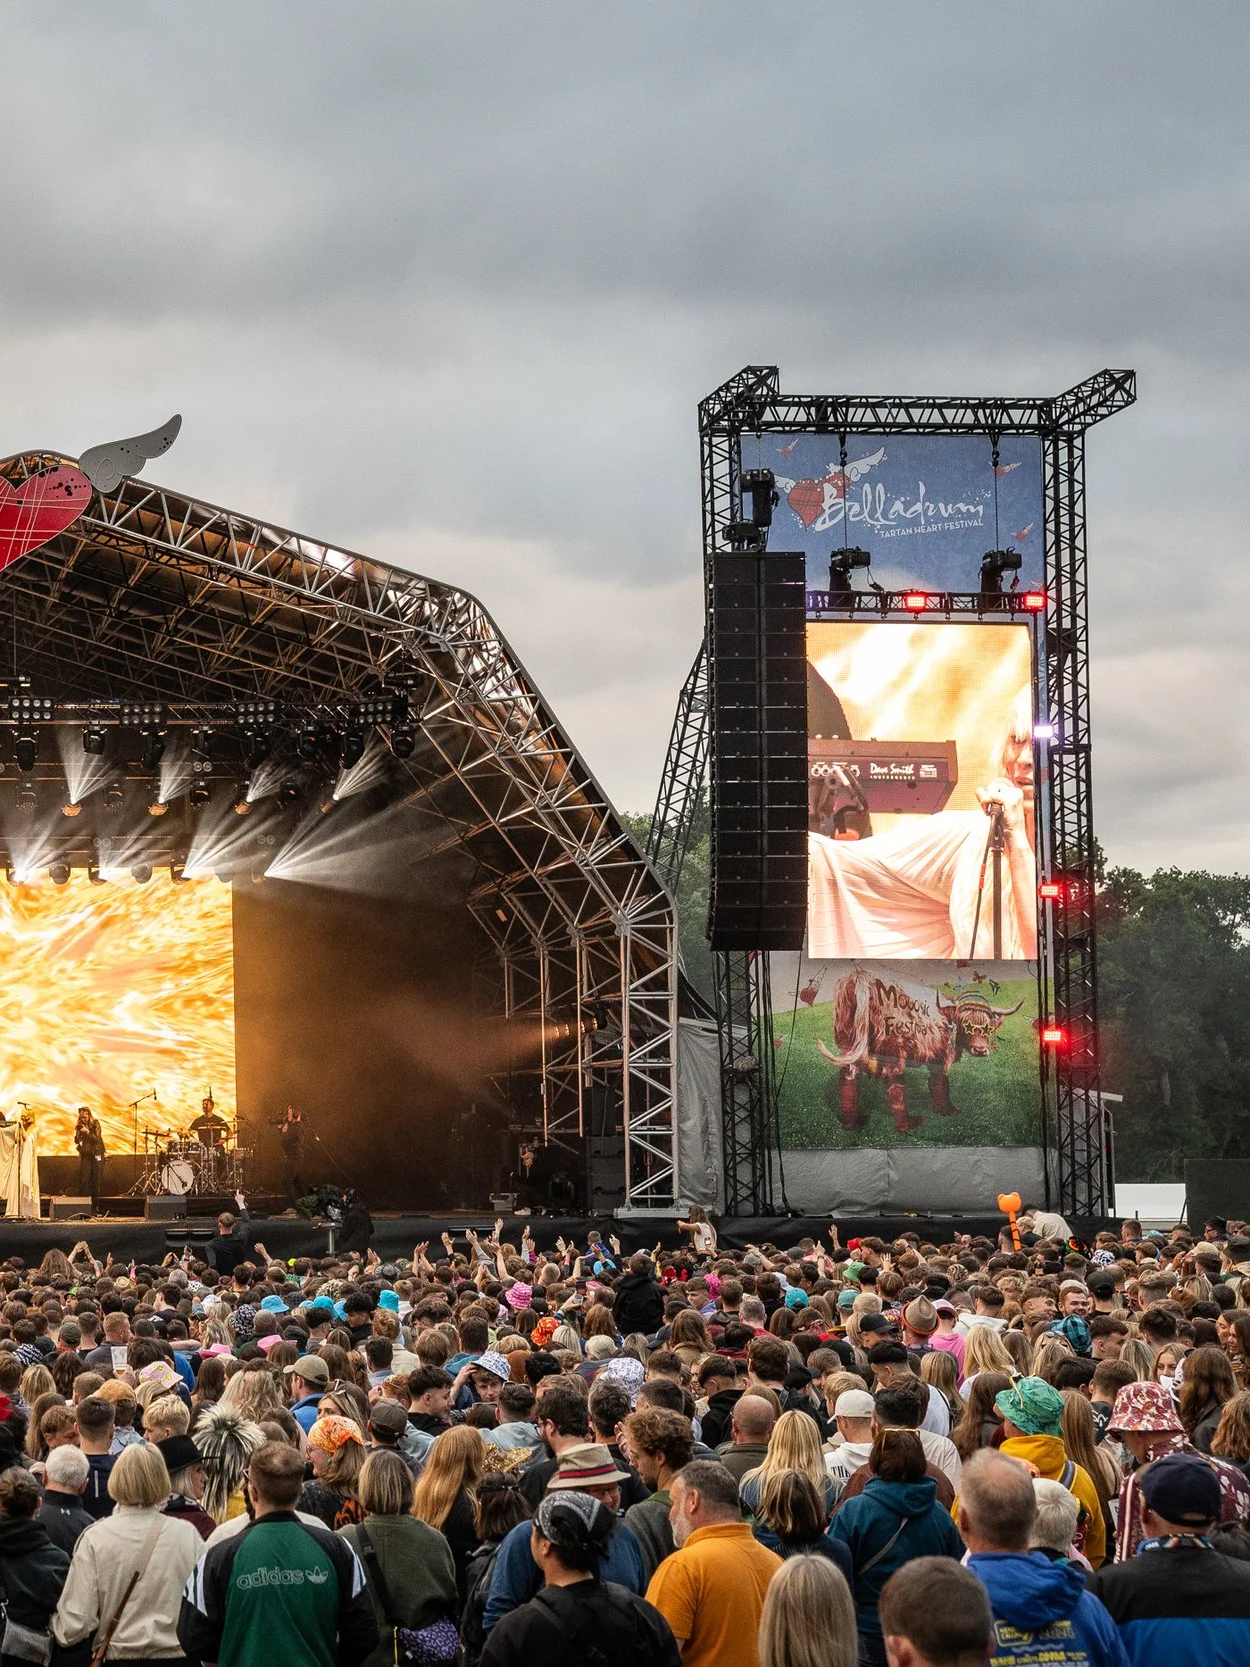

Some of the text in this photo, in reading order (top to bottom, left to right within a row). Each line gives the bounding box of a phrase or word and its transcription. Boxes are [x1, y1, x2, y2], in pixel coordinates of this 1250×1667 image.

[815, 481, 984, 532] Belladrum
[879, 519, 984, 539] TARTAN HEART FESTIVAL
[884, 1016, 928, 1036] Festiva
[237, 1566, 305, 1590] adidas
